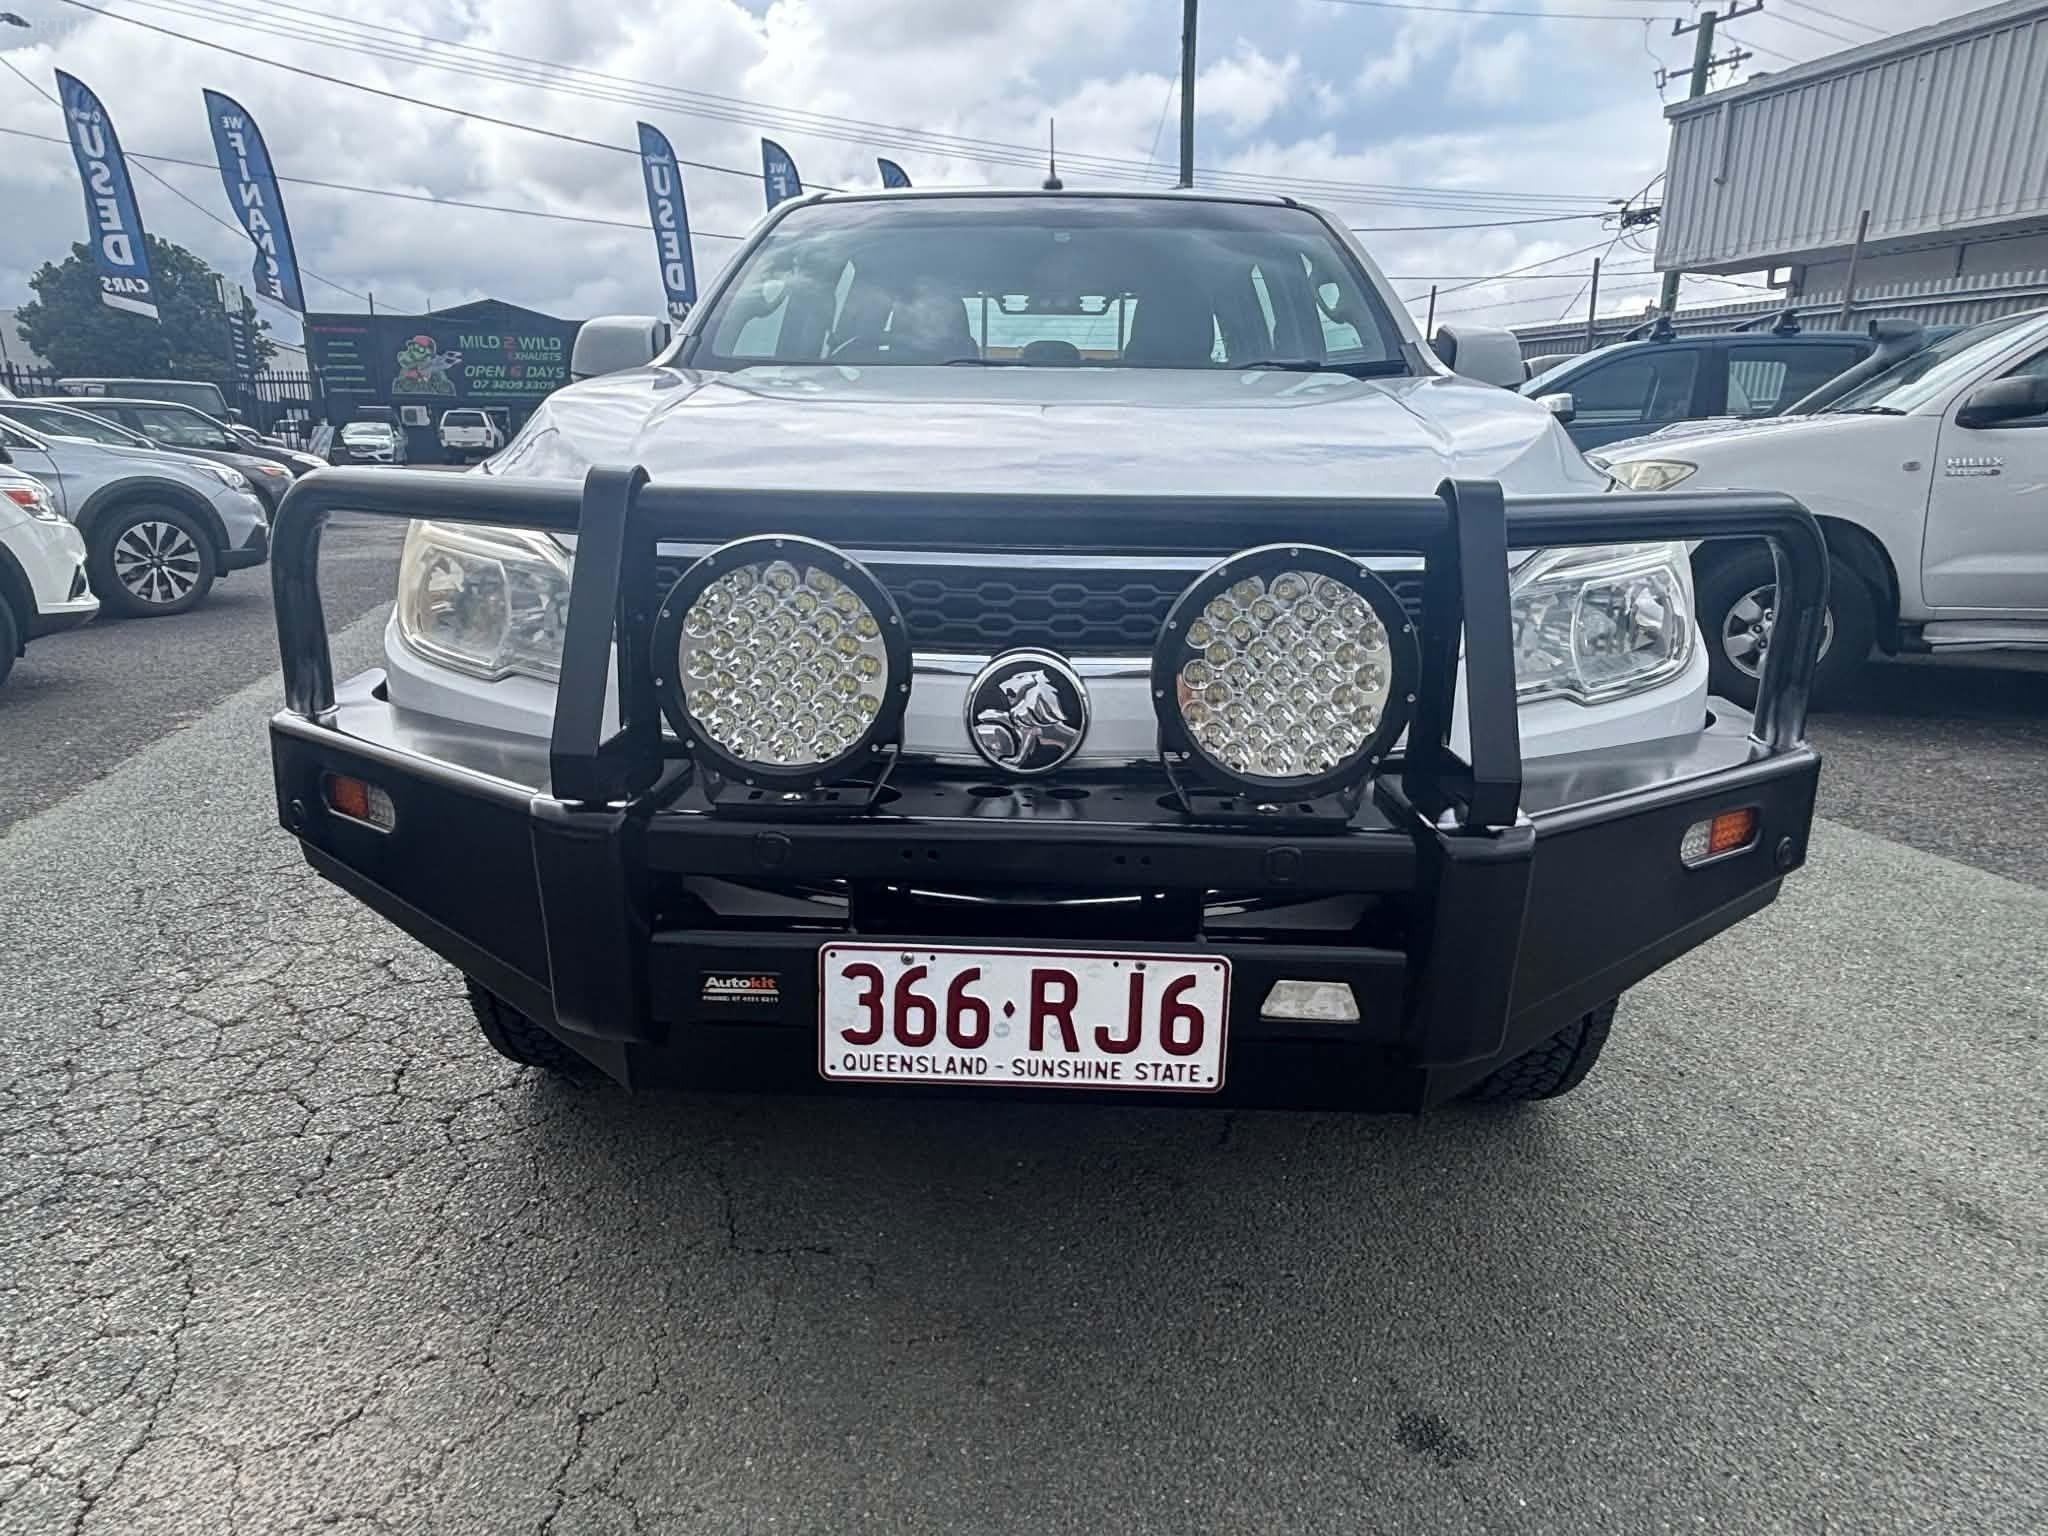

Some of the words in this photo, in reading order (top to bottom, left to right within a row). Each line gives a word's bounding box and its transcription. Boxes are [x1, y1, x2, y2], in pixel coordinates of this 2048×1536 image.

[459, 335, 501, 349] MILD
[503, 336, 515, 349] 2
[518, 336, 561, 351] WILD
[464, 365, 506, 378] OPEN
[526, 366, 566, 379] DAYS
[473, 380, 489, 389] 07
[1946, 456, 2003, 466] HILUX
[705, 976, 777, 989] Autokit
[843, 1053, 987, 1075] QUEENSLAND
[1012, 1058, 1122, 1080] SUNSHINE
[1135, 1062, 1201, 1082] STATE
